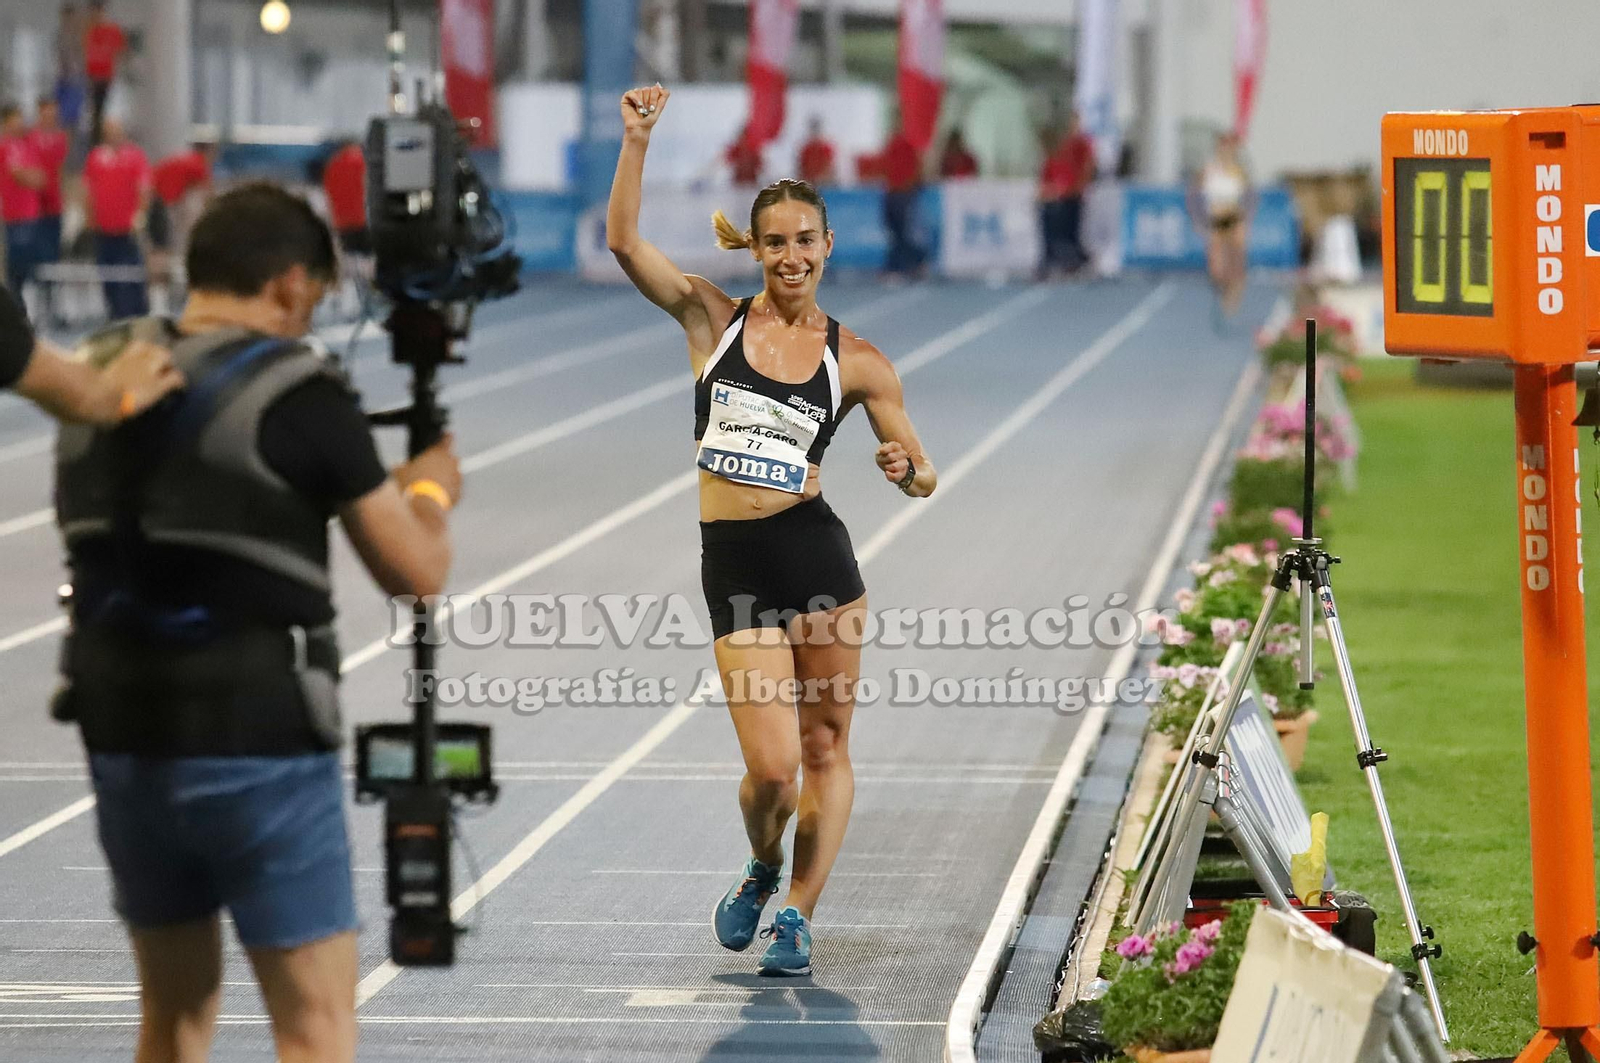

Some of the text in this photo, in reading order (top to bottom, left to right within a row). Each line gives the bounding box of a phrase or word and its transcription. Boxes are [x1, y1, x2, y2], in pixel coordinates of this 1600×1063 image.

[1413, 128, 1469, 156] MONDO
[1412, 171, 1494, 304] 00
[1535, 164, 1564, 315] MONDO
[739, 401, 766, 414] HUELVA
[747, 438, 763, 450] 77
[1521, 444, 1551, 592] MONDO
